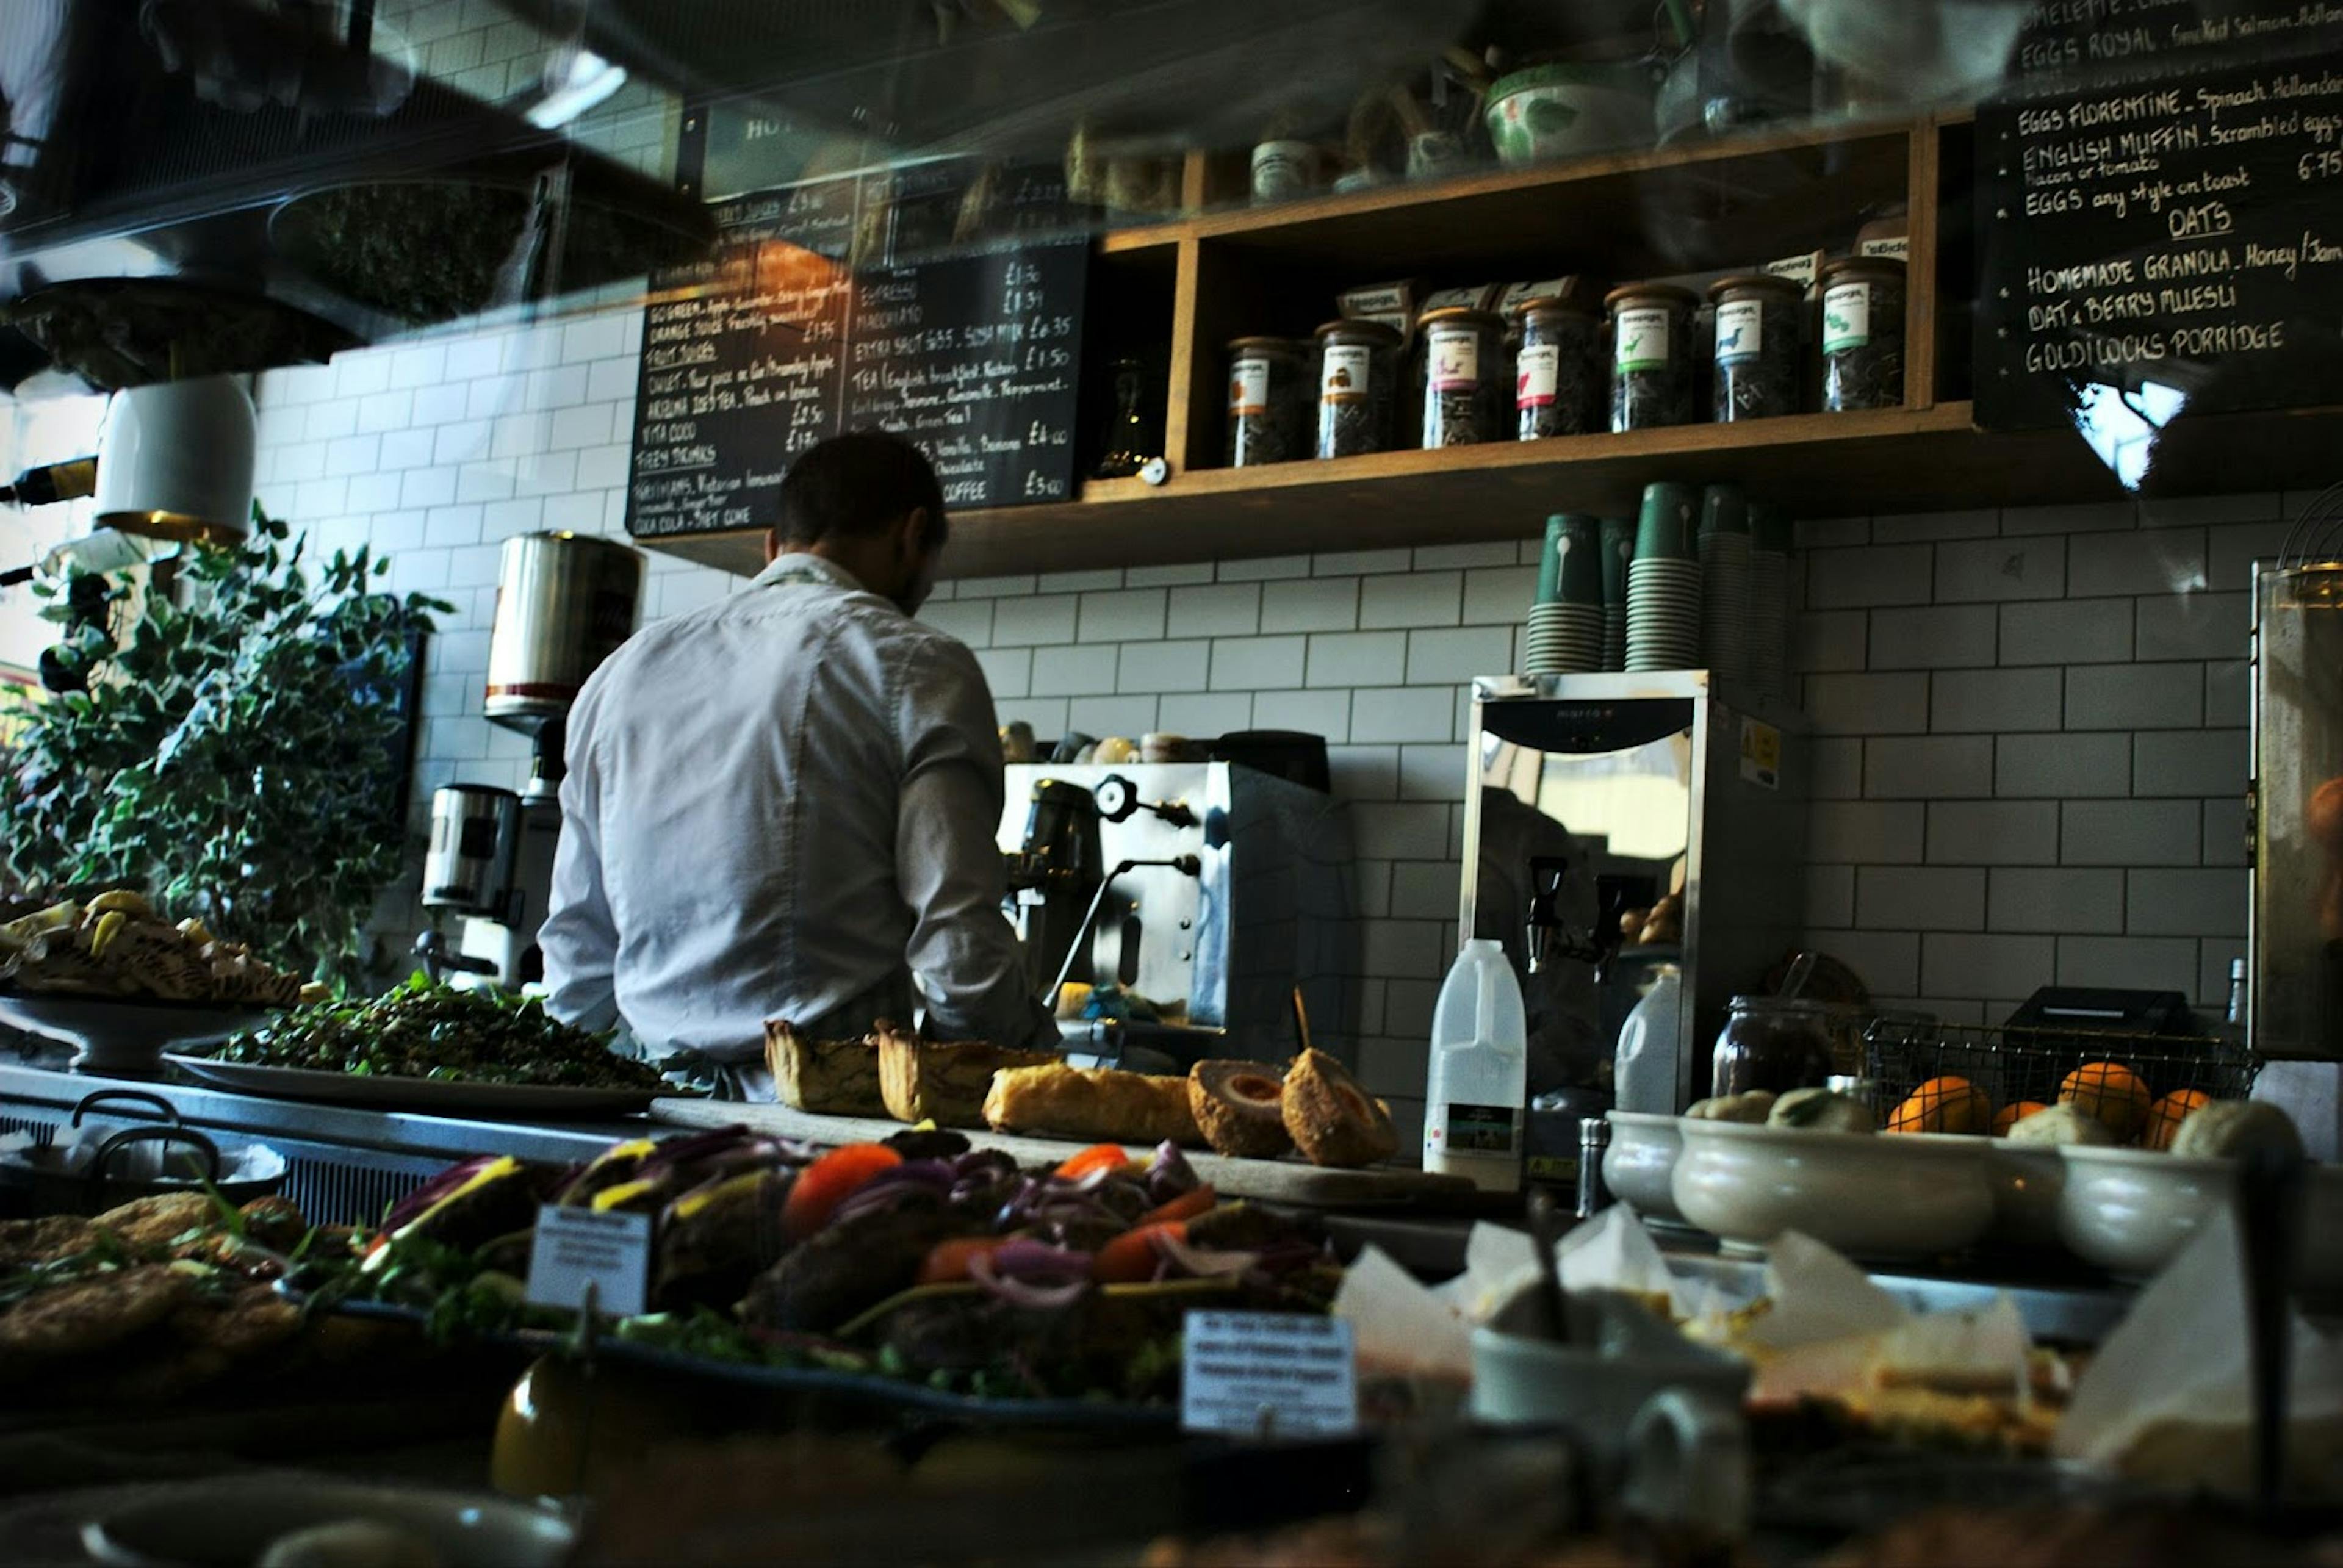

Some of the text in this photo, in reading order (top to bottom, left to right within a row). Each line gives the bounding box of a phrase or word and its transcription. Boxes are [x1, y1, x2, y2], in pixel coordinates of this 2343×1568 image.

[2021, 38, 2079, 67] EGGS
[2089, 26, 2156, 58] ROYAL
[2172, 18, 2228, 46] Smoked
[2018, 110, 2062, 135] EGGS
[2068, 90, 2180, 127] FLORENTINE
[2023, 111, 2341, 171] ENGLISH MUFFIN Scrambled eggs
[2079, 167, 2092, 181] or
[2097, 157, 2160, 177] tomato
[2026, 167, 2250, 218] EGGS any style on toast
[2169, 201, 2231, 238] OATS
[2028, 259, 2134, 293] HOMEMADE
[2144, 246, 2229, 281] GRANOLA
[2245, 243, 2296, 281] Honey
[2028, 301, 2071, 331] OAT
[2087, 290, 2154, 323] BERRY
[2160, 275, 2236, 315] MUESLI
[650, 325, 691, 345] ORANGE
[694, 321, 723, 337] JUICE
[2026, 320, 2284, 373] GOLDILOCKS PORRIDGE
[646, 346, 677, 366] FRUIT
[852, 369, 877, 392] TEA
[672, 445, 716, 466] DRINKS
[944, 480, 986, 503] COFFEE
[635, 517, 657, 535] COCA
[659, 515, 685, 532] COLA
[724, 507, 750, 526] COKE
